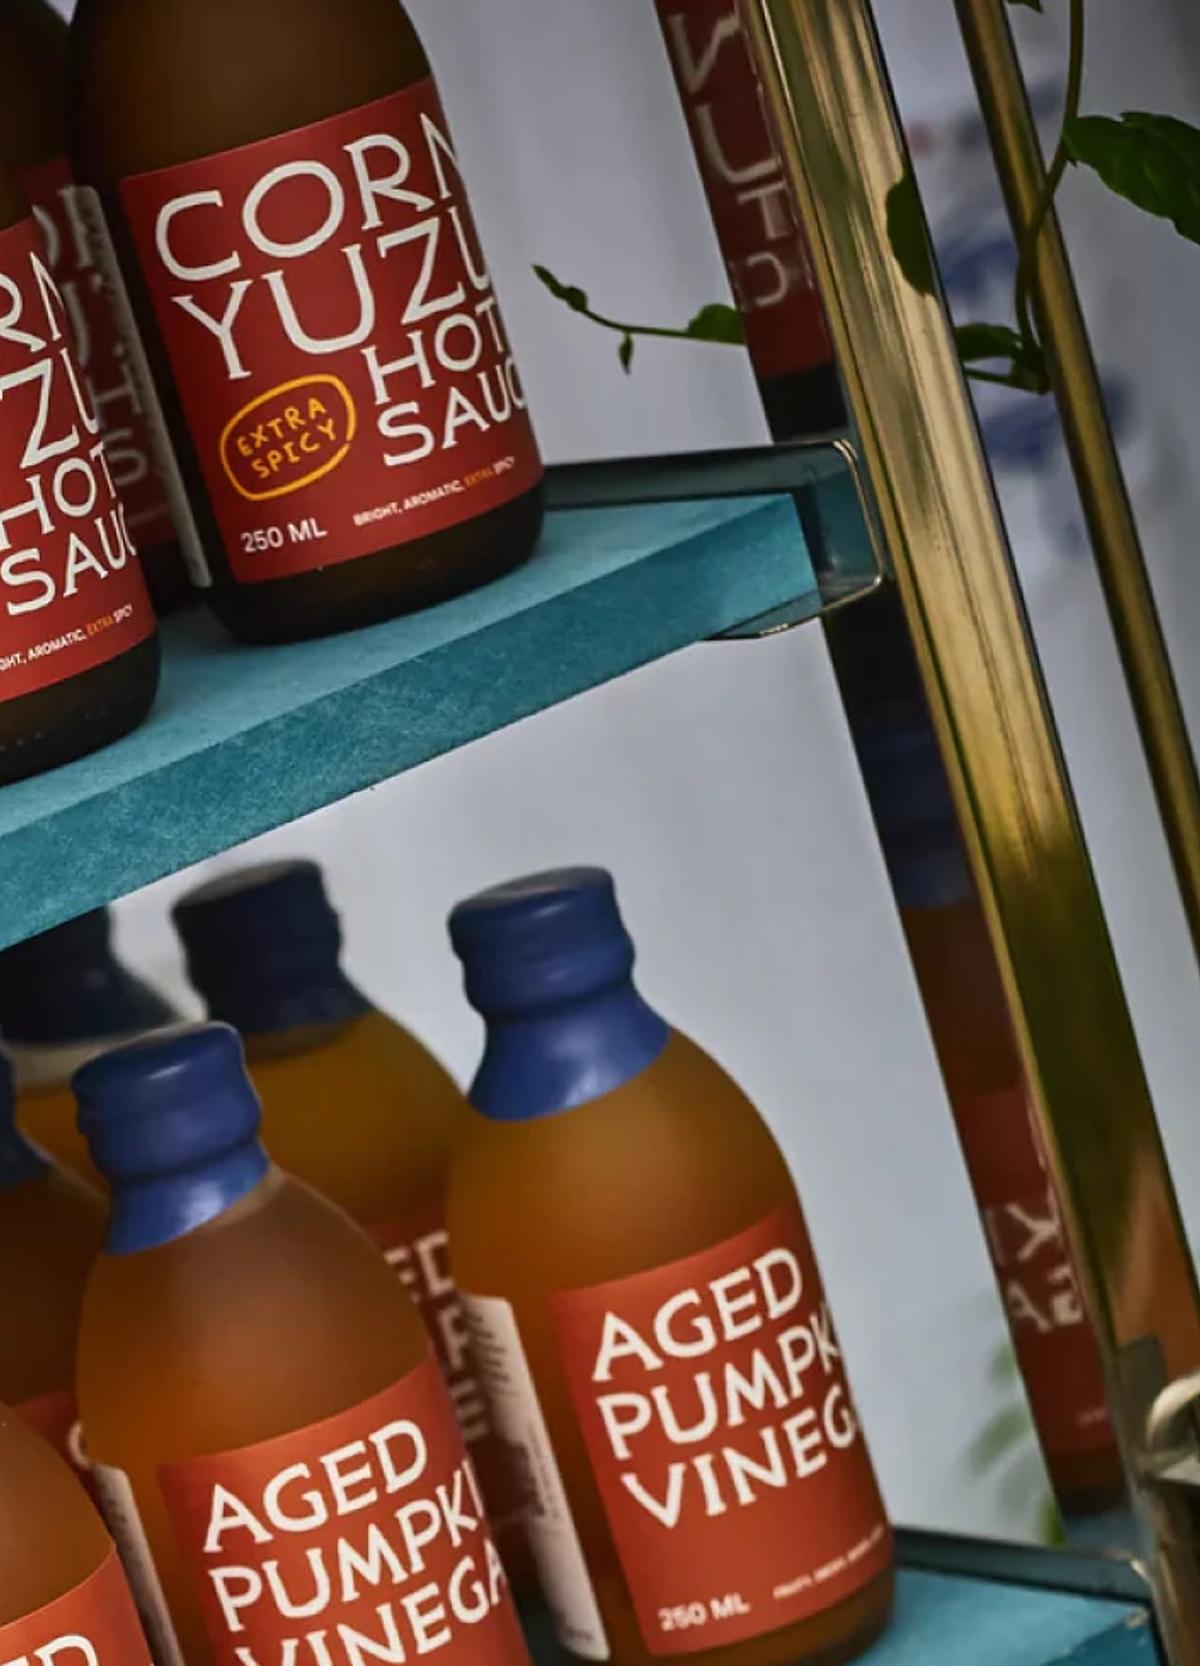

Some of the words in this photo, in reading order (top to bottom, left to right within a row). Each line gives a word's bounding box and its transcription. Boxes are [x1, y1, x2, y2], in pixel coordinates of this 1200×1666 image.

[361, 296, 504, 405] HOT
[236, 398, 327, 455] EXTRA
[251, 417, 338, 480] SPICY
[240, 529, 283, 553] 250
[288, 517, 329, 543] ML
[353, 502, 403, 527] BRIGHT,
[592, 1248, 803, 1381] AGED
[203, 1419, 427, 1553] AGED
[658, 1603, 705, 1630] 250
[711, 1594, 750, 1621] ML
